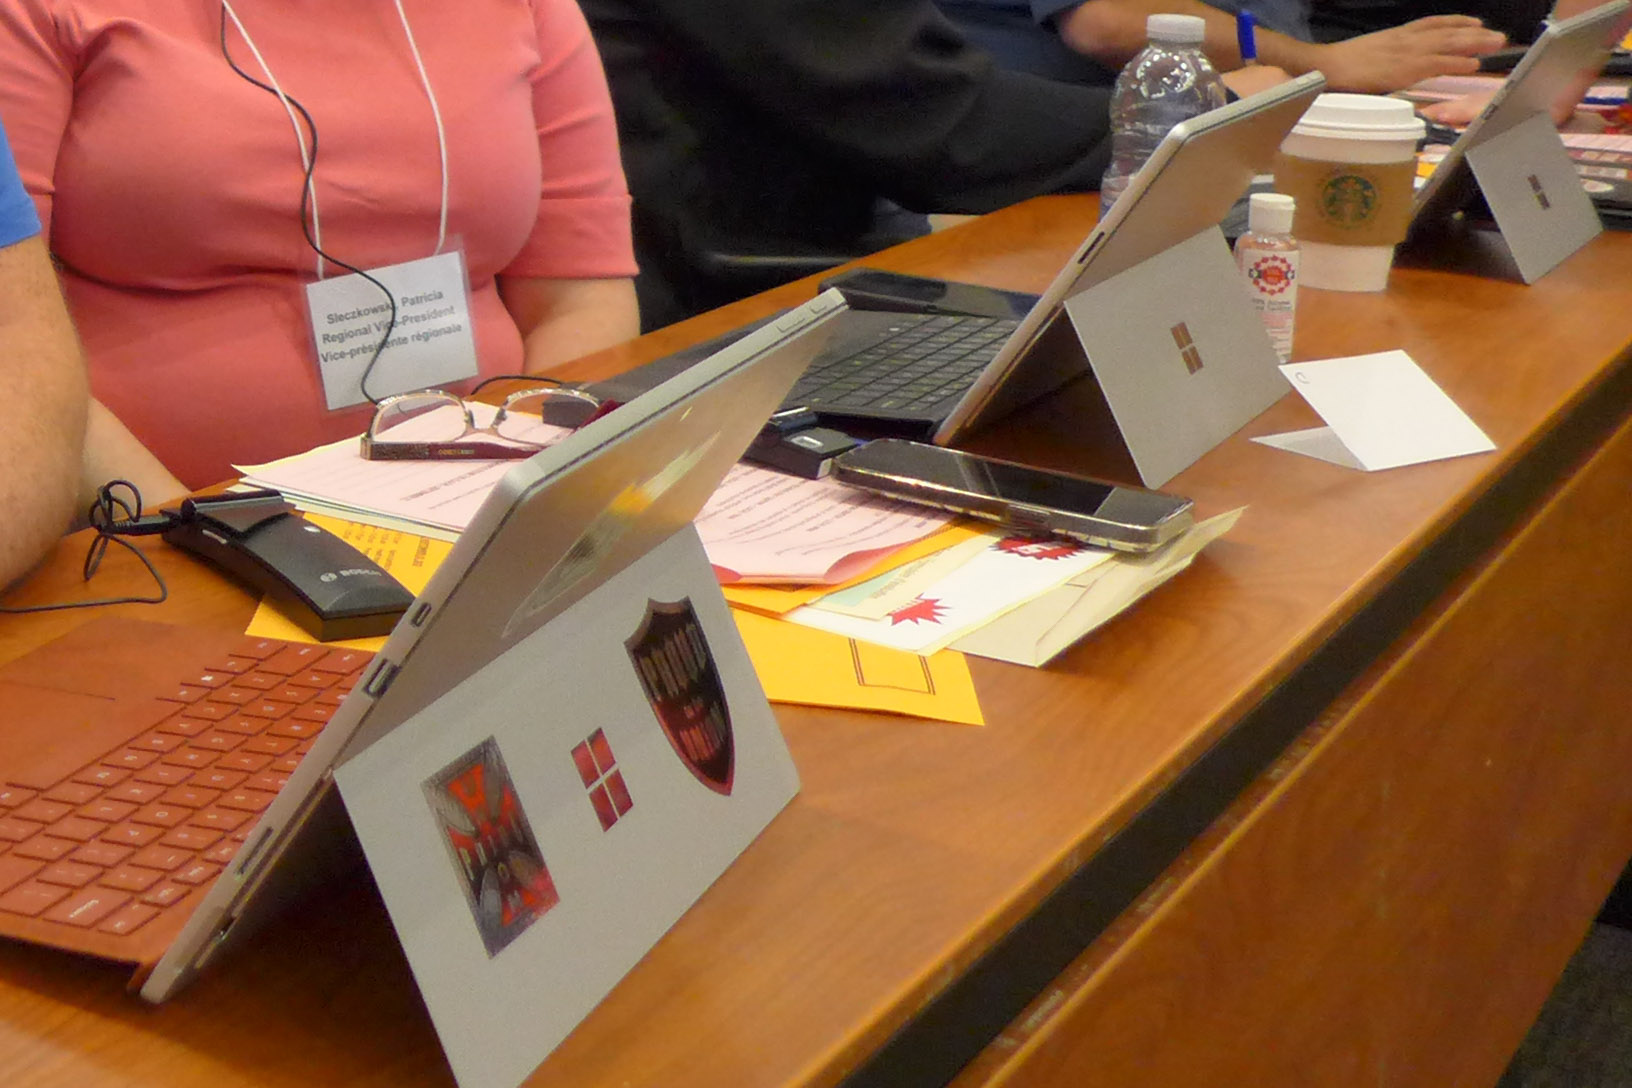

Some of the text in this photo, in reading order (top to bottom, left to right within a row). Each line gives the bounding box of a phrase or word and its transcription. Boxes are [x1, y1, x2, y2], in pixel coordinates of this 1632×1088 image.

[401, 290, 444, 307] Patricia
[321, 324, 462, 363] Vice-présiente régionale
[322, 306, 456, 345] Regional Vice-President
